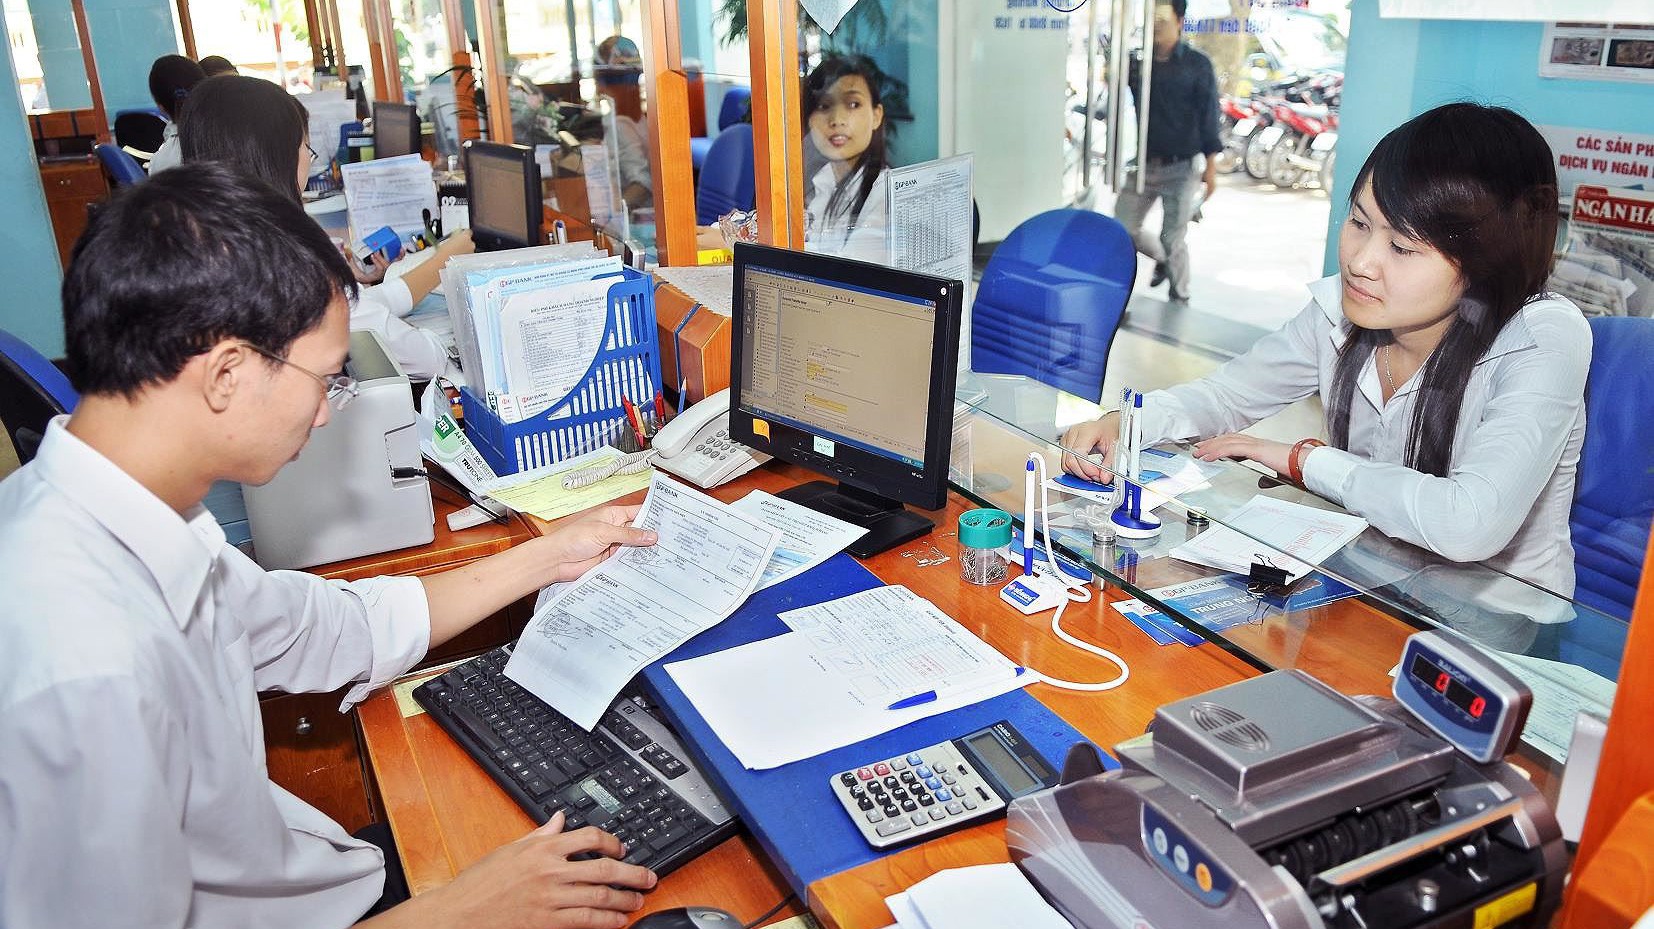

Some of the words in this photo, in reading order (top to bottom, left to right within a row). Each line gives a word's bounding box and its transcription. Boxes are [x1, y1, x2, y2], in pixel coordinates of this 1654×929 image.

[1576, 134, 1601, 151] CÁC
[1559, 154, 1588, 170] DỊCH
[1592, 159, 1608, 174] VỤ
